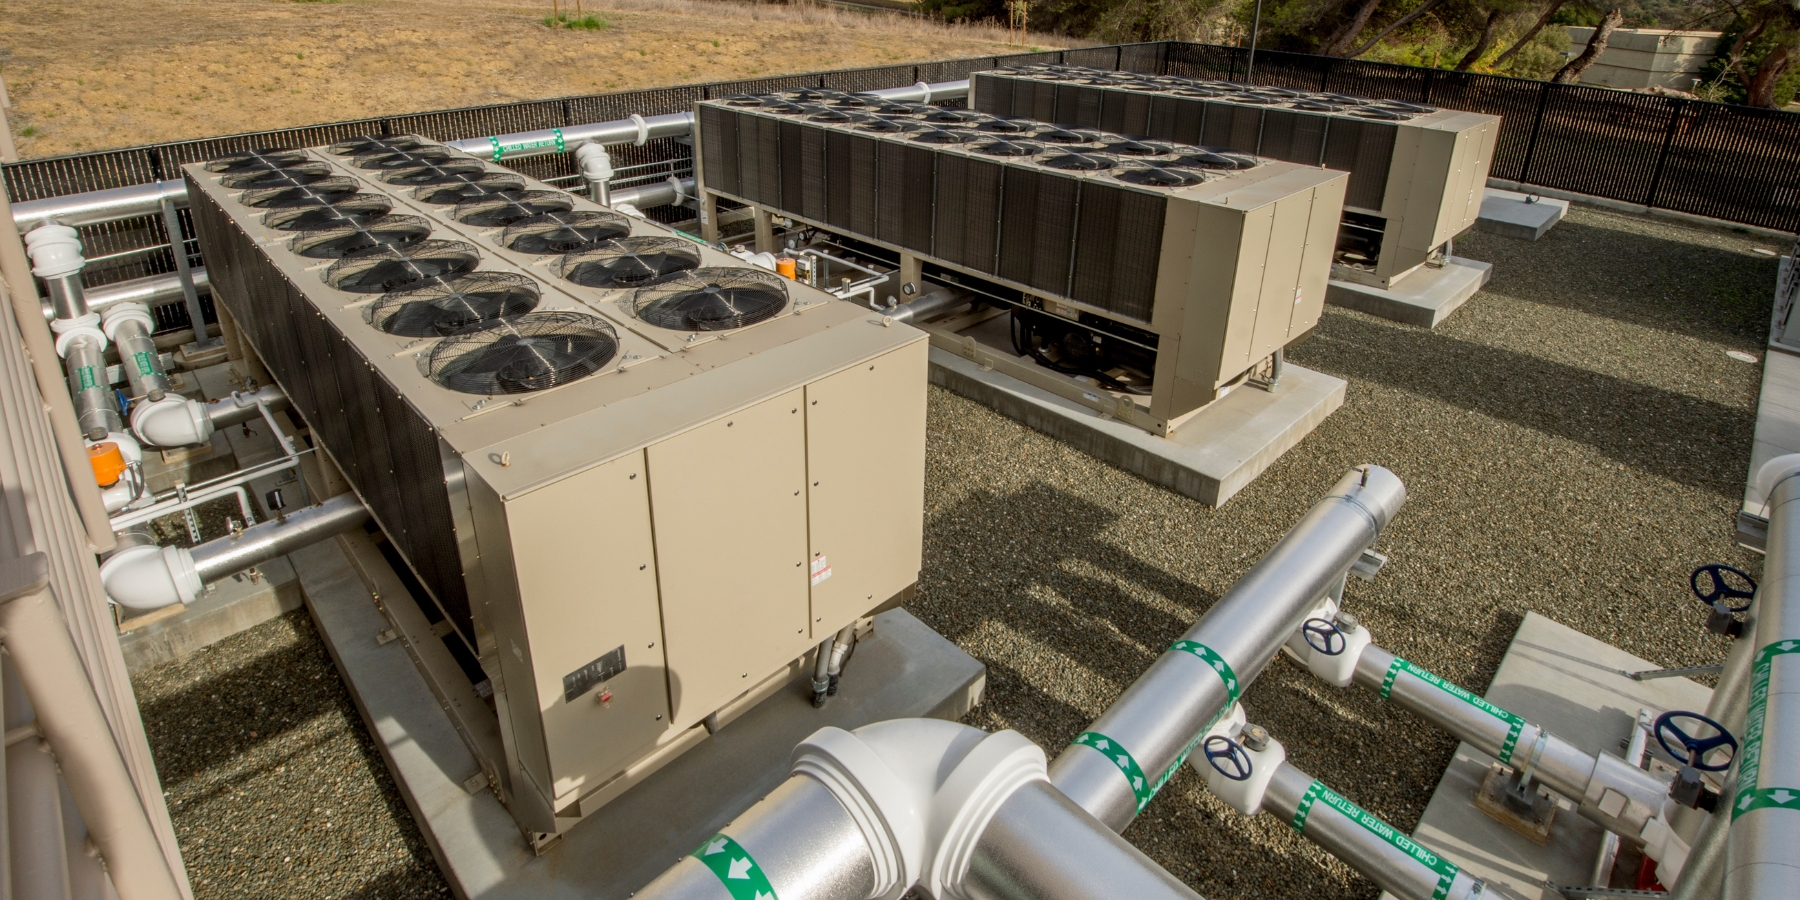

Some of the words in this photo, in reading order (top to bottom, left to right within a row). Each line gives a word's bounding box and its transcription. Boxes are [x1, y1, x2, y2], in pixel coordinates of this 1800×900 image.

[1407, 664, 1441, 685] RETURN
[1749, 662, 1770, 708] CHILLED
[1442, 680, 1471, 700] WATER
[1472, 697, 1509, 719] CHILLED
[1743, 702, 1766, 746] WATER
[1736, 740, 1761, 797] RETURN
[1321, 790, 1361, 819] RETURN
[1361, 814, 1394, 840] WATER
[1395, 835, 1438, 866] CHILLED
